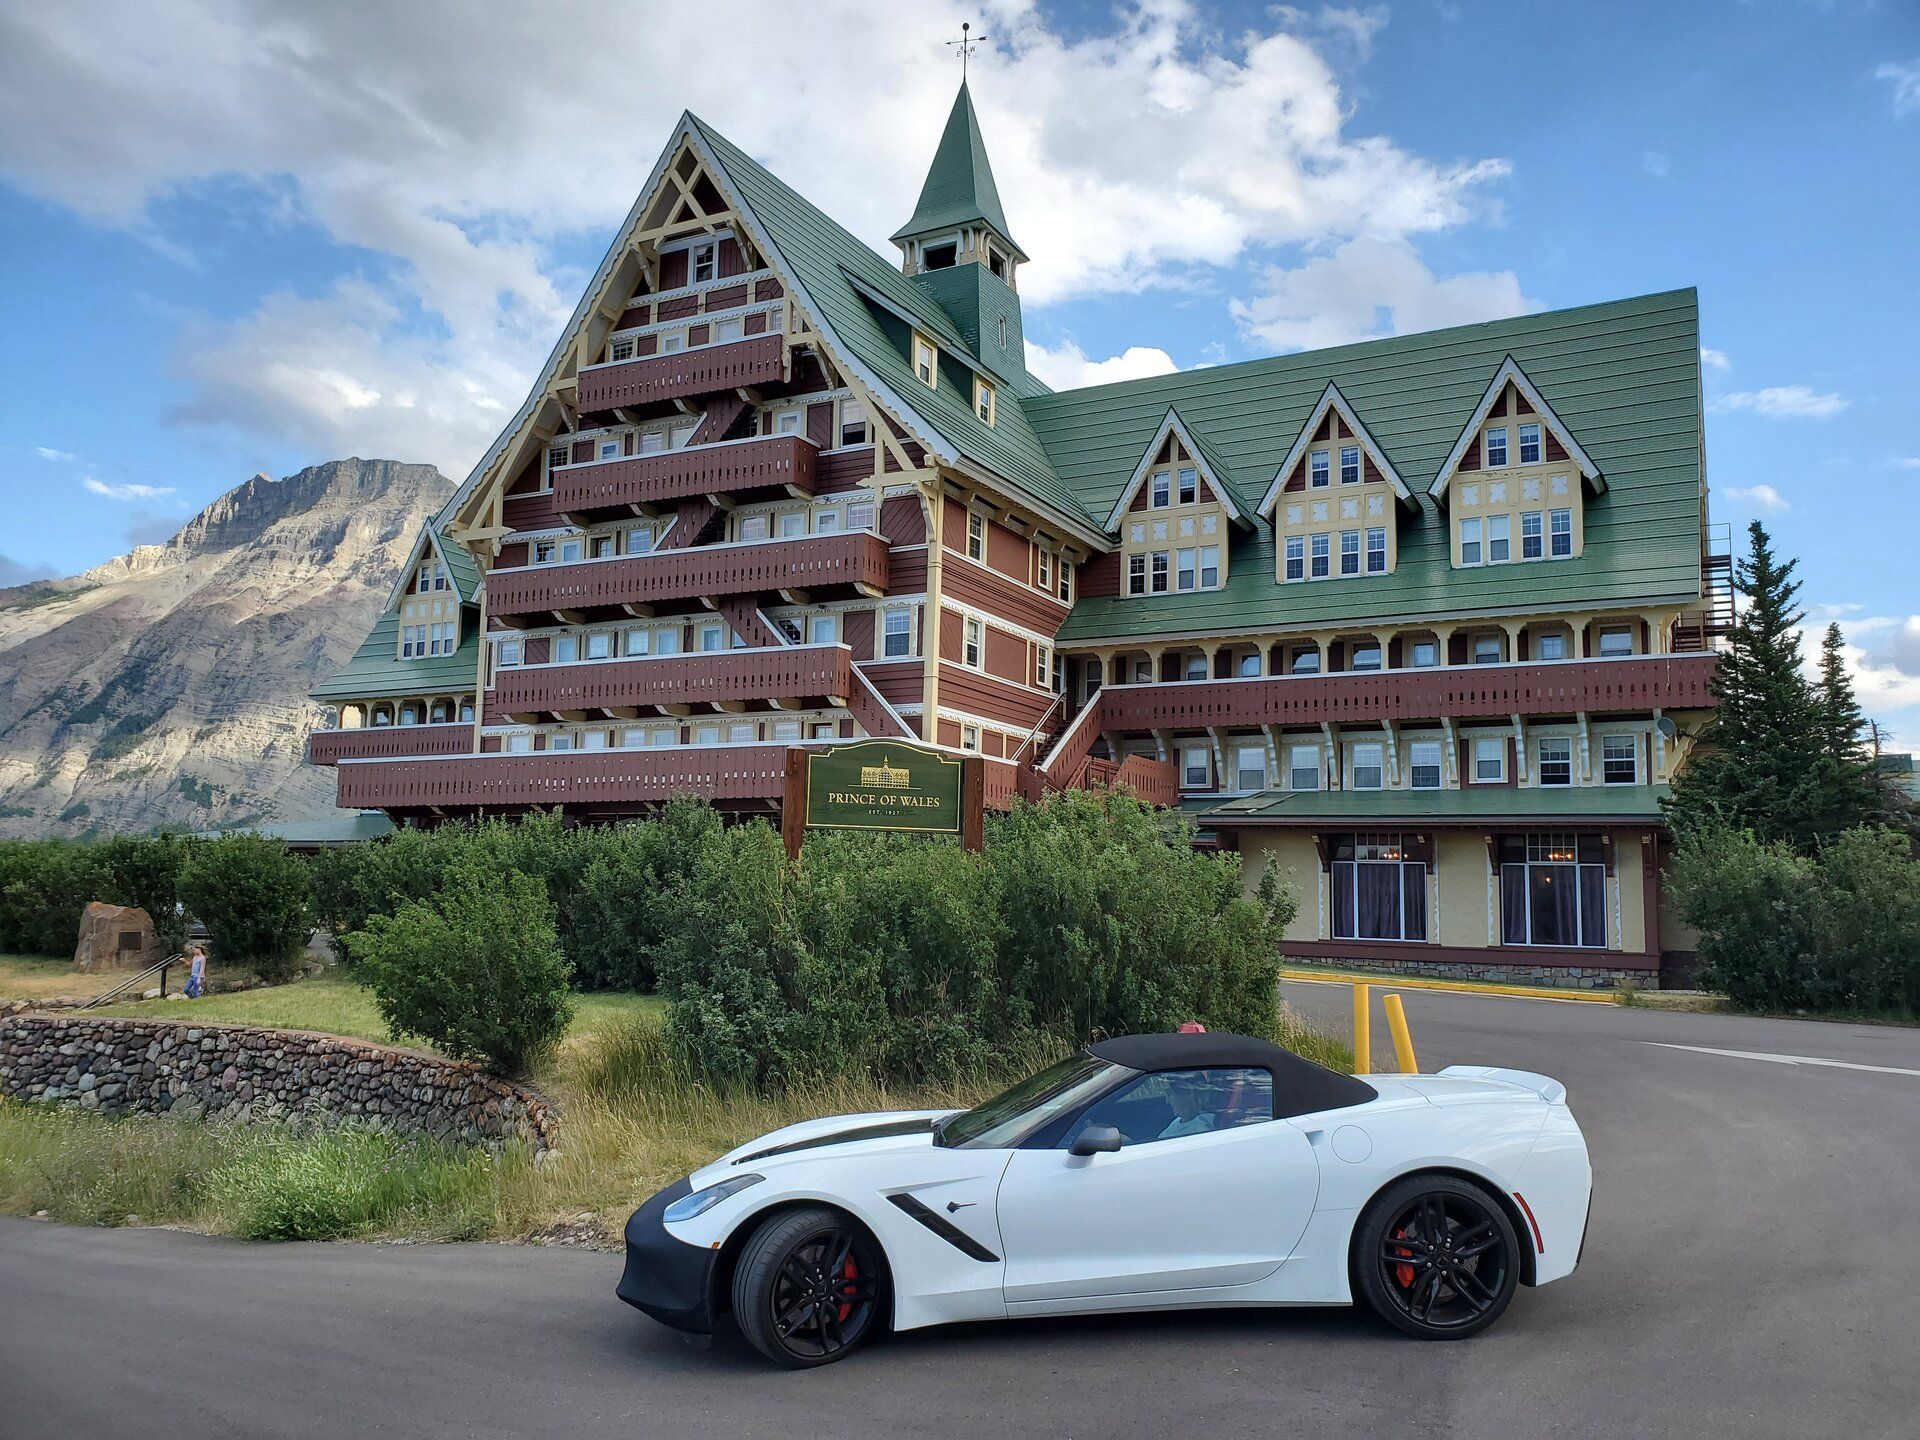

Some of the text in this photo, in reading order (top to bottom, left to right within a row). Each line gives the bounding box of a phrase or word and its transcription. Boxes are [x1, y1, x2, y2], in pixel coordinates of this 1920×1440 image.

[828, 792, 940, 808] PRINCE OF WALES
